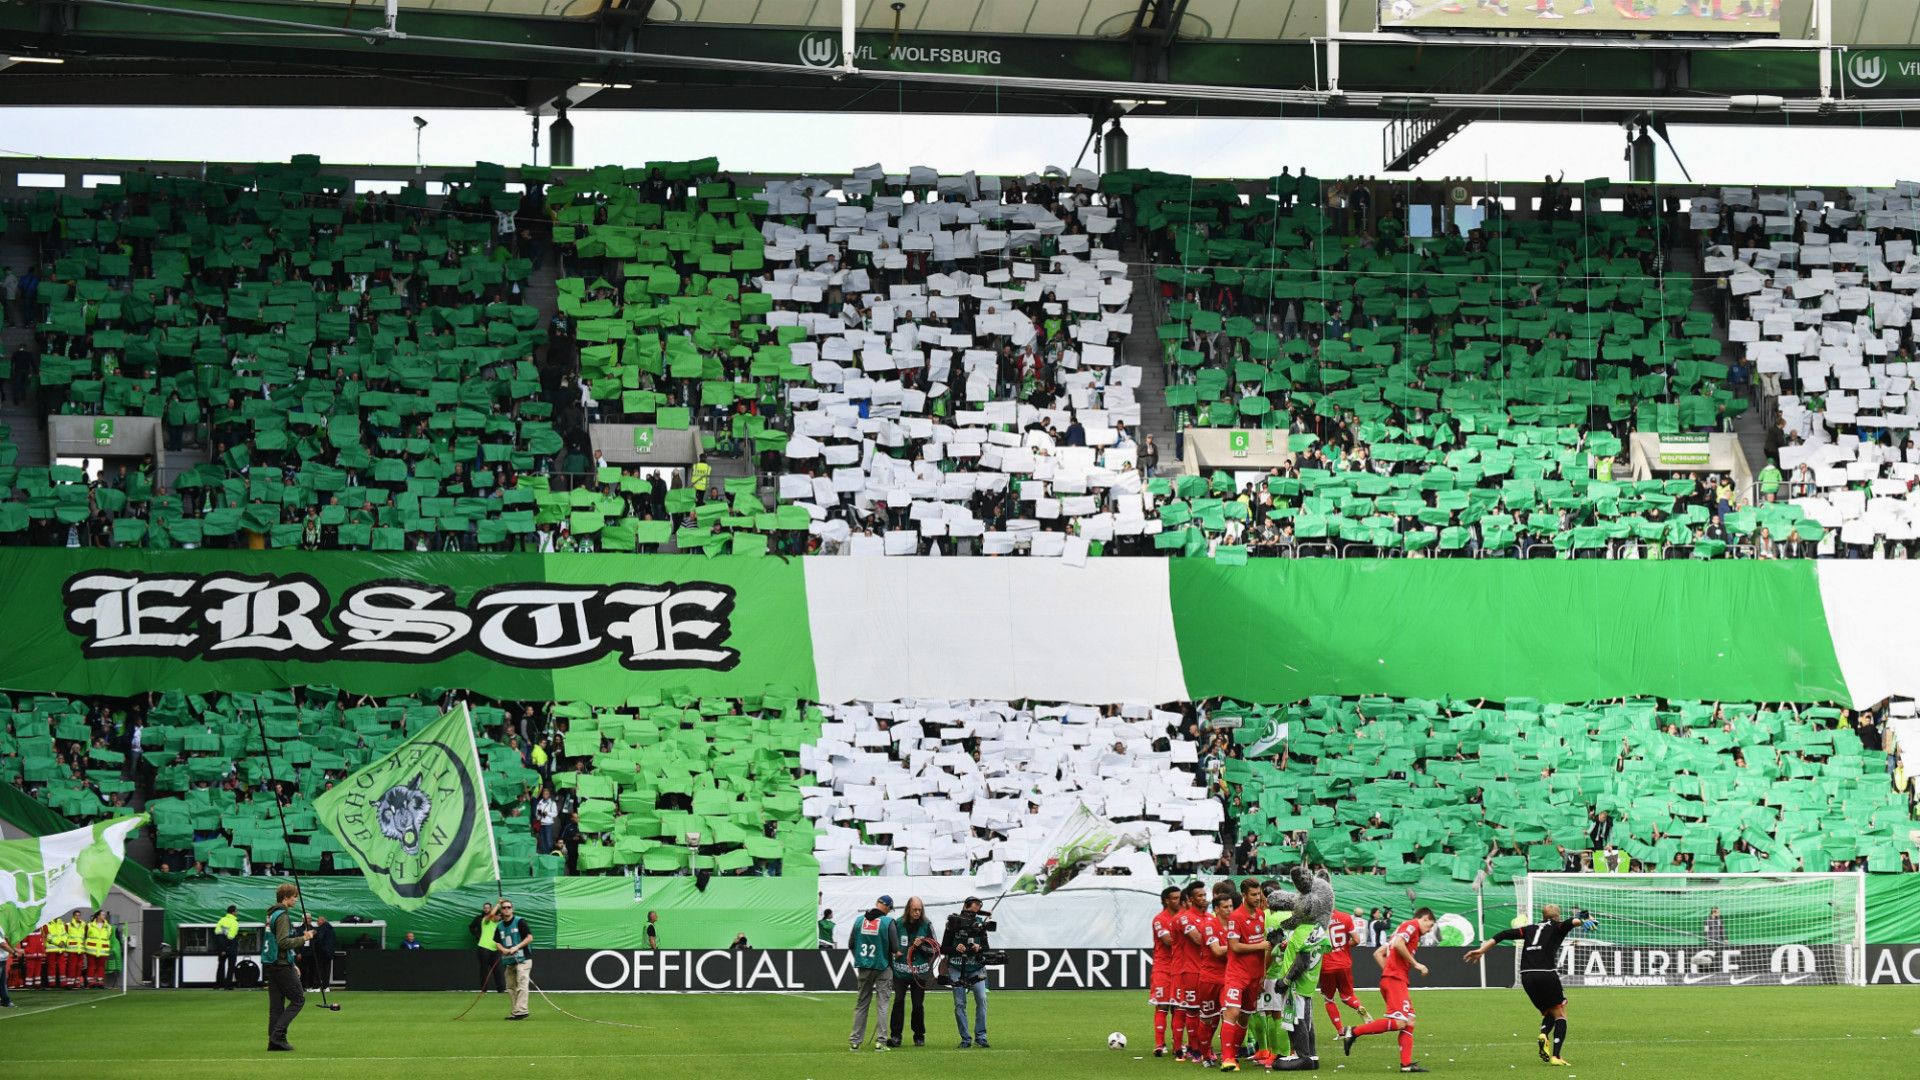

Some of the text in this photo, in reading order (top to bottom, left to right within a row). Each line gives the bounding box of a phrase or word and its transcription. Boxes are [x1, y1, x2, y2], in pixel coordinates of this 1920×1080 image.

[889, 46, 1001, 64] WOLFSBURG
[100, 423, 109, 434] 2
[639, 431, 648, 442] 4
[1235, 435, 1244, 447] 6
[66, 572, 741, 668] ERSTE
[860, 943, 876, 958] 32
[585, 949, 804, 989] OFFICIAL
[1227, 988, 1240, 1000] 42
[1202, 1000, 1214, 1011] 20
